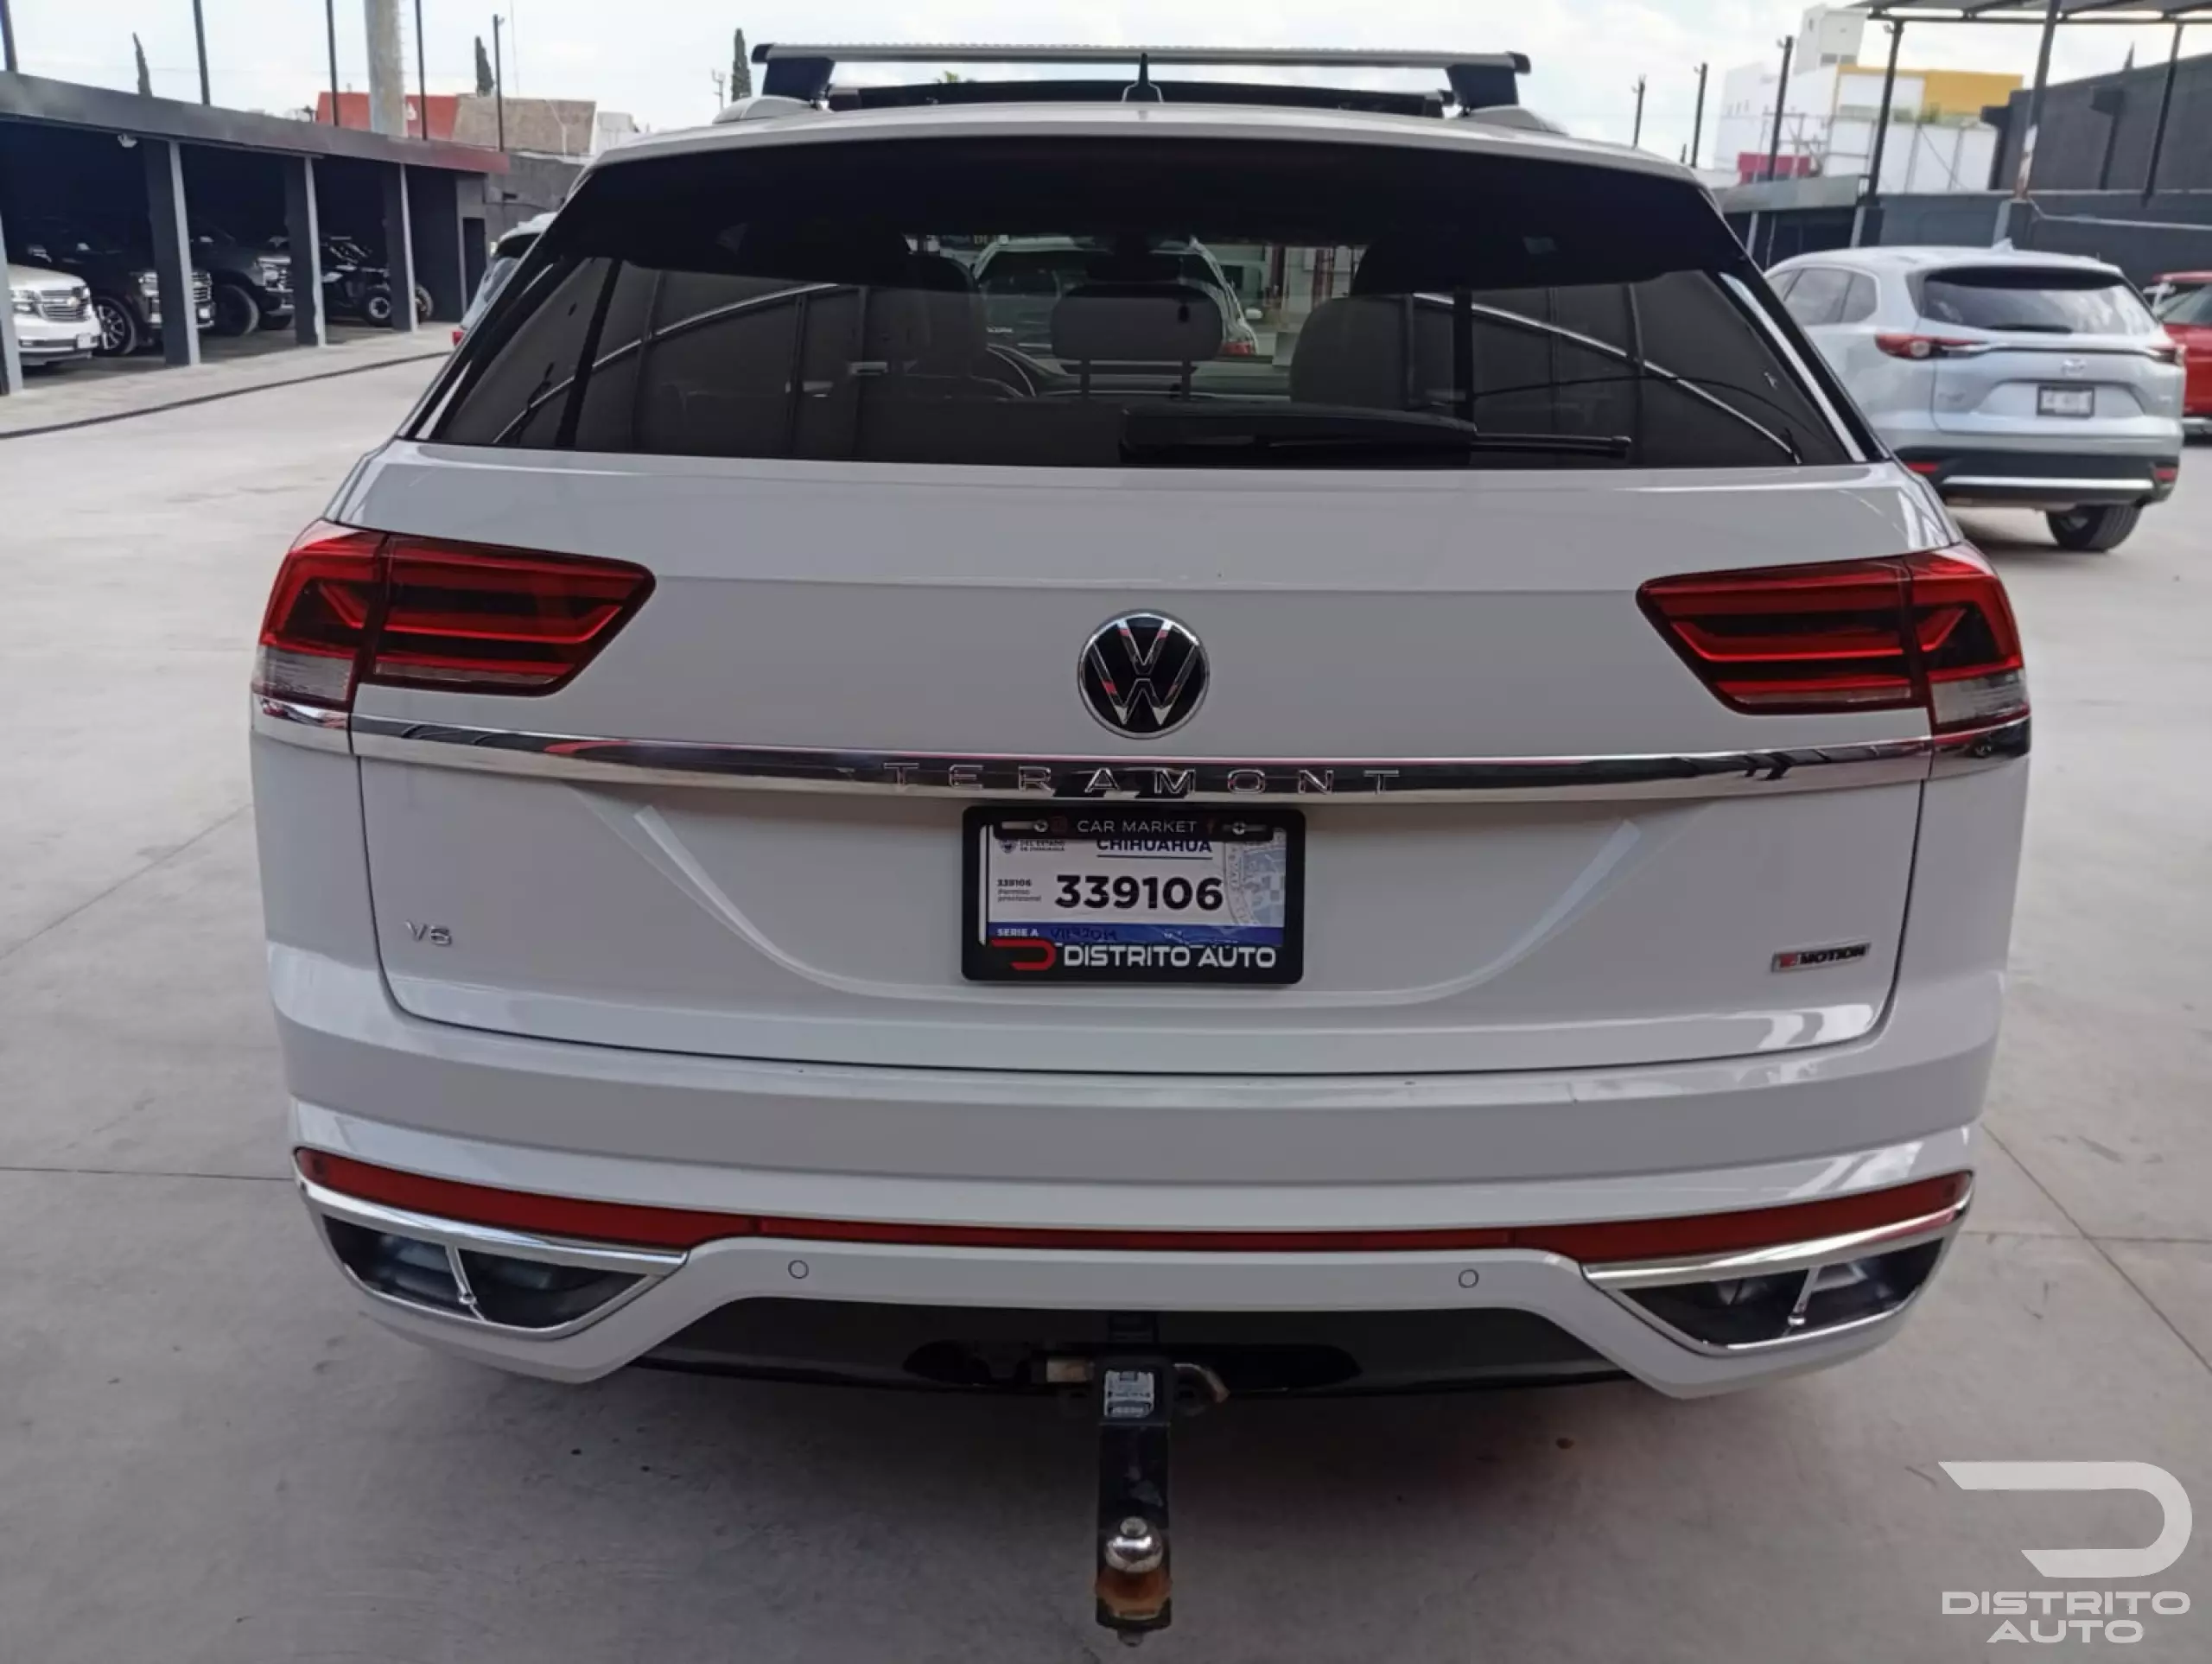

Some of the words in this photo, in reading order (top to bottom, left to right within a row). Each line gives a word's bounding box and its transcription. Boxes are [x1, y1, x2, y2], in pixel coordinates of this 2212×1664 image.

[882, 761, 1400, 796] TERAMONT
[1077, 819, 1116, 834] CAR
[1122, 820, 1198, 834] MARKET
[1096, 839, 1213, 854] CHIHUAHUA
[1054, 873, 1224, 911] 339106
[404, 920, 453, 947] V6
[996, 928, 1028, 937] SERIE
[1029, 929, 1039, 937] A
[1064, 944, 1191, 969] DISTRITO
[1197, 945, 1277, 969] AUTO
